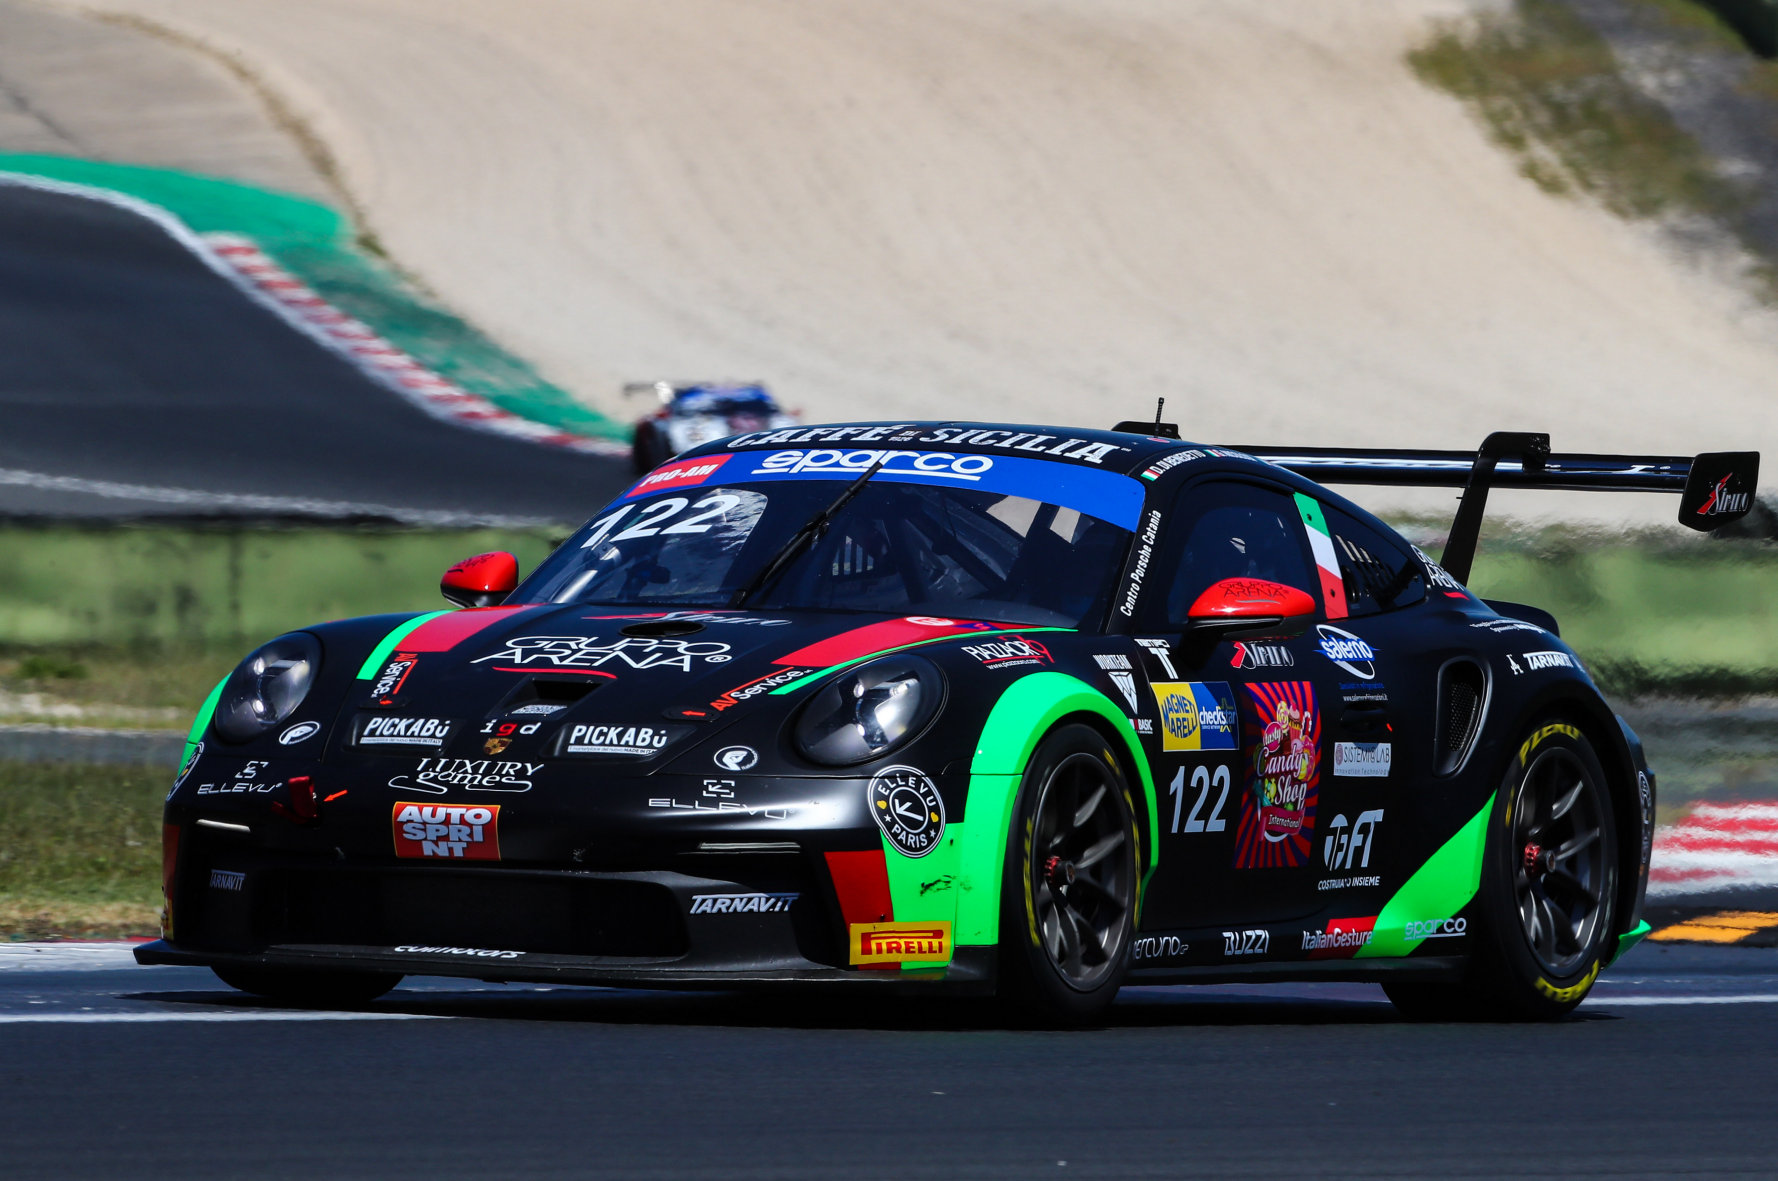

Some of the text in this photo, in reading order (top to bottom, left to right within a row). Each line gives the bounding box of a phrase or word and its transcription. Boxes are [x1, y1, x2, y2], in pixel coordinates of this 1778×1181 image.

[920, 427, 1113, 465] SICILIA
[757, 448, 994, 477] sparco
[639, 464, 719, 488] PRO-AM
[580, 494, 741, 549] 122
[1120, 510, 1162, 617] Centro Porsche Catania
[505, 636, 731, 656] GRUPPO
[1321, 636, 1374, 660] salerno
[470, 648, 691, 673] ARENA
[416, 757, 545, 776] LUXURY
[1257, 744, 1303, 778] Candy
[197, 782, 277, 795] ELLEVU
[878, 773, 937, 807] ELLEVU
[1169, 764, 1231, 834] 122
[1274, 774, 1307, 810] Shop
[396, 805, 493, 826] AUTO
[1268, 814, 1300, 828] International
[402, 822, 485, 842] SPRI
[891, 823, 928, 848] PARIS
[421, 840, 468, 857] NT
[1351, 875, 1381, 887] INSIEME
[689, 892, 801, 915] TARNAV.IT
[1404, 917, 1467, 940] sparco
[860, 929, 944, 956] PIRELLI
